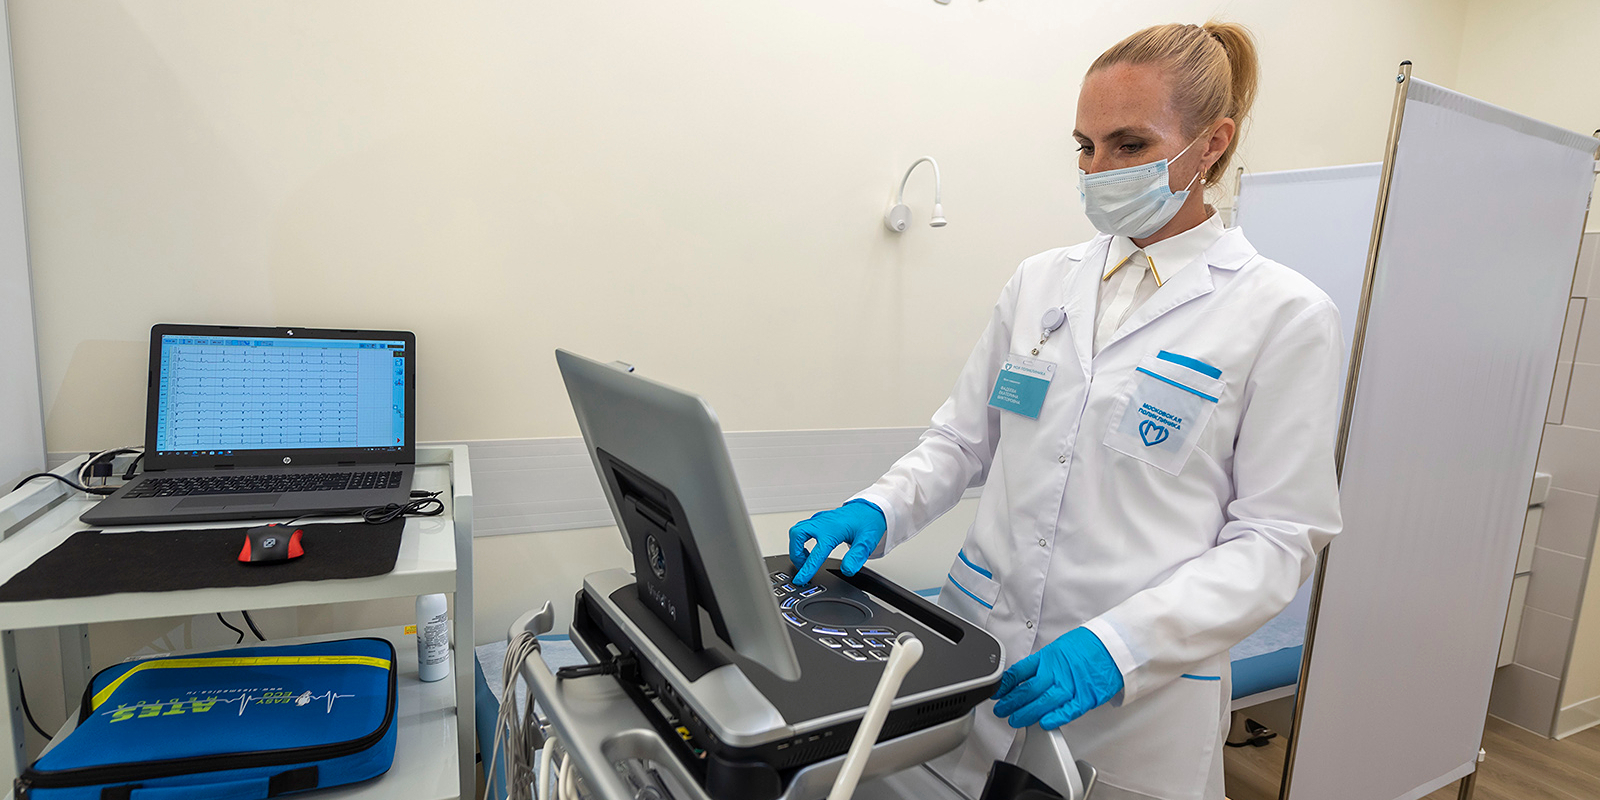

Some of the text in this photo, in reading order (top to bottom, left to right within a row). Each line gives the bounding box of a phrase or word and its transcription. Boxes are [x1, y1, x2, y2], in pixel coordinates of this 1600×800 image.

[1138, 407, 1181, 430] ПОЛИКЛИНИКА
[1142, 402, 1183, 424] МОСКОВСКАЯ
[117, 696, 218, 710] MEDICA
[255, 696, 291, 705] EASY
[109, 700, 218, 724] ATES
